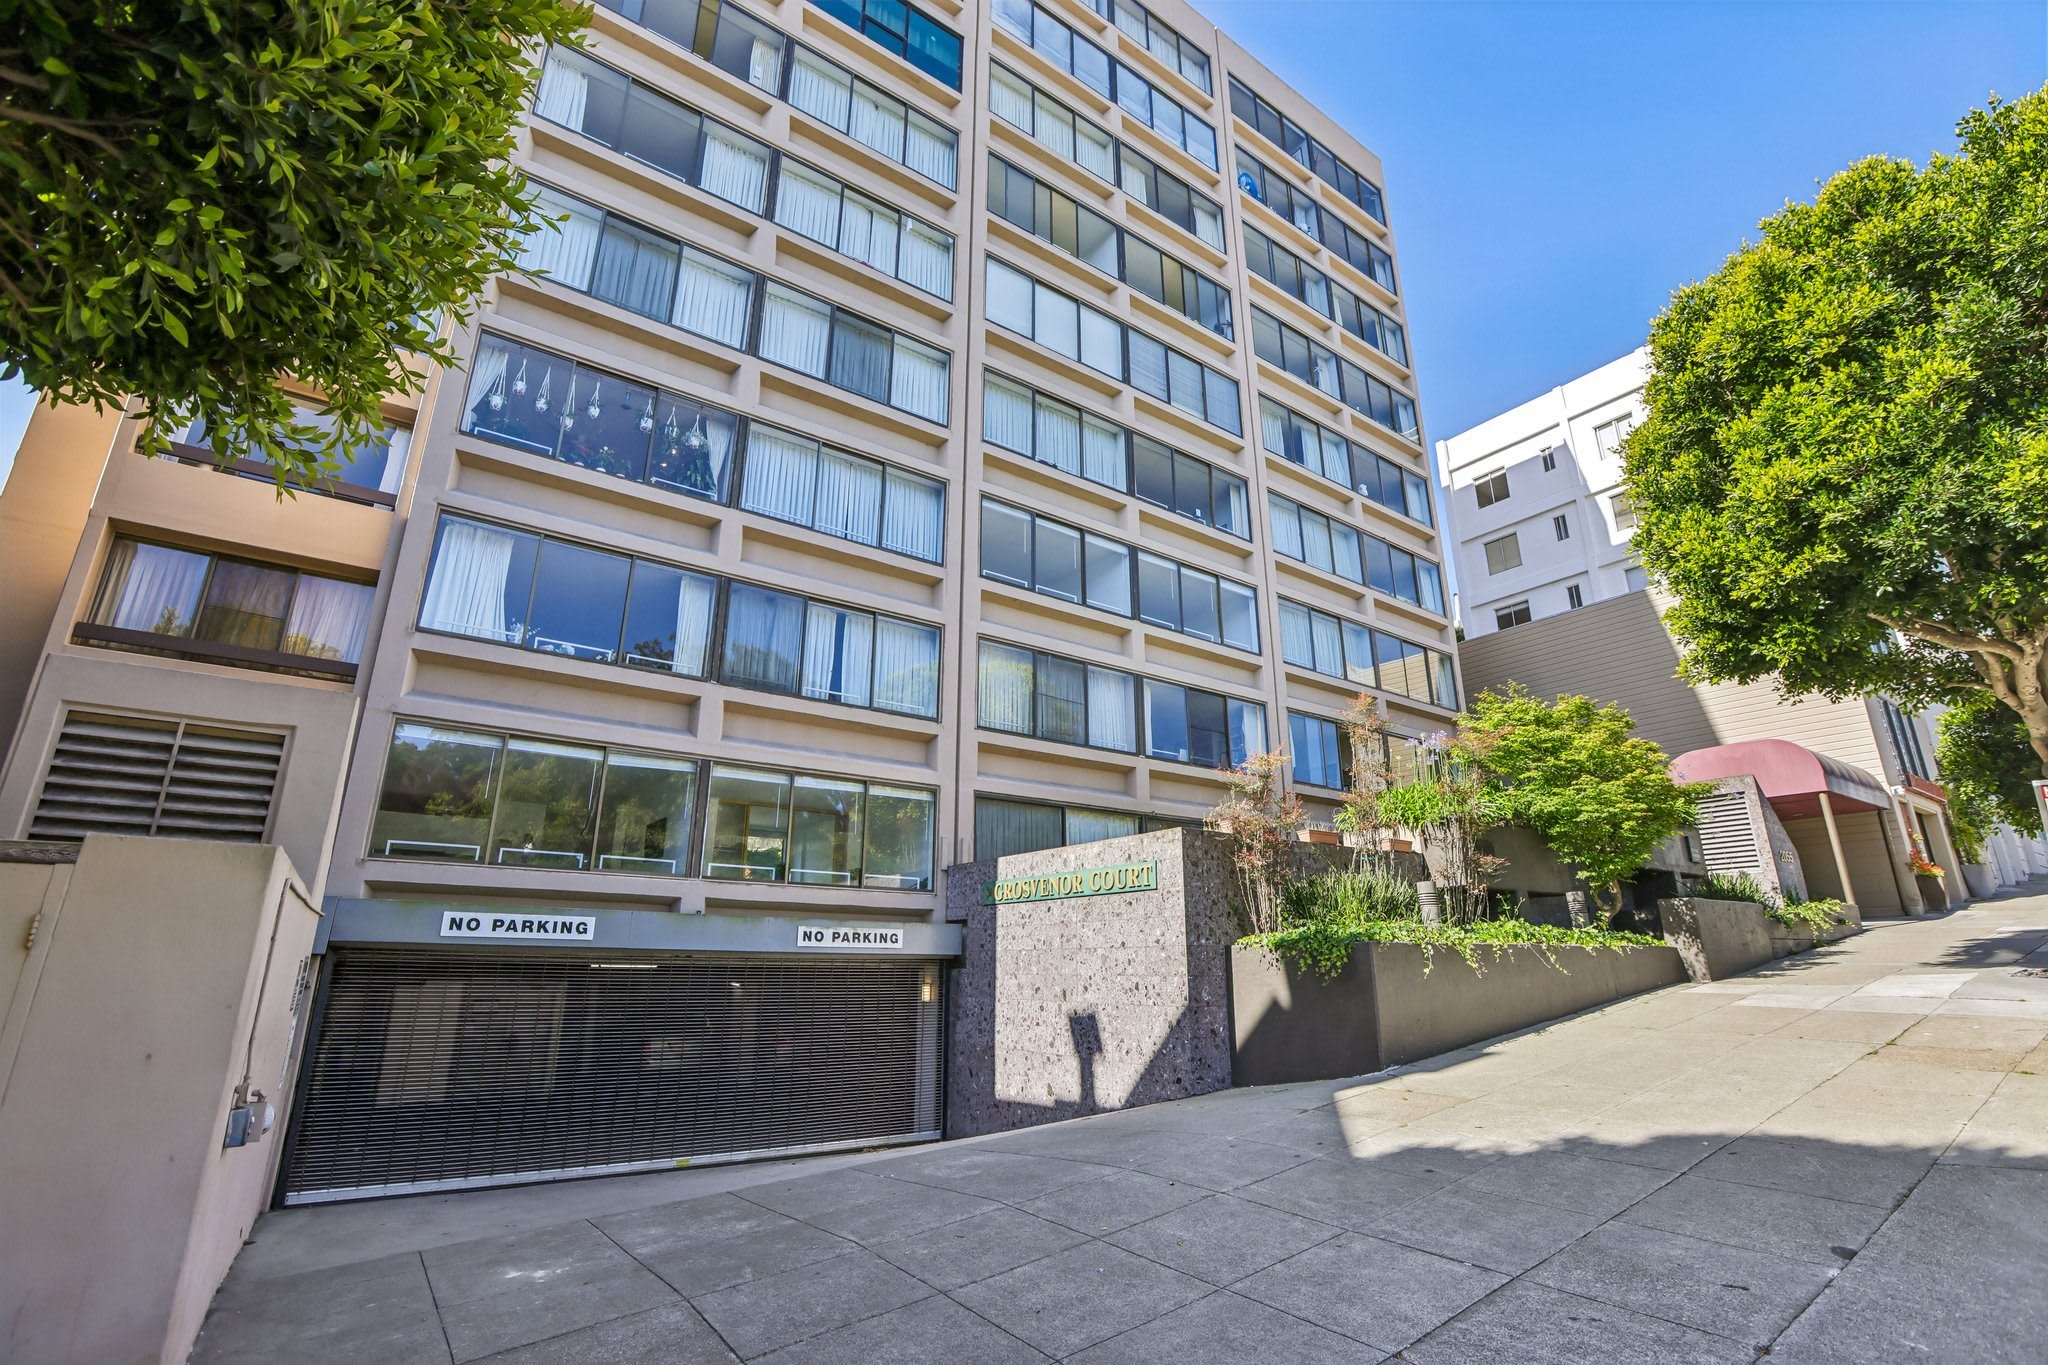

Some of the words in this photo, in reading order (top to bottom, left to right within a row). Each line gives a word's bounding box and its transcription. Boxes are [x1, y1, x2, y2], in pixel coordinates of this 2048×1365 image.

[993, 875, 1084, 902] GROSVENOR
[1089, 866, 1152, 892] COURT
[449, 917, 481, 932] NO
[492, 919, 588, 935] PARKING
[802, 930, 825, 943] NO
[831, 931, 899, 944] PARKING
